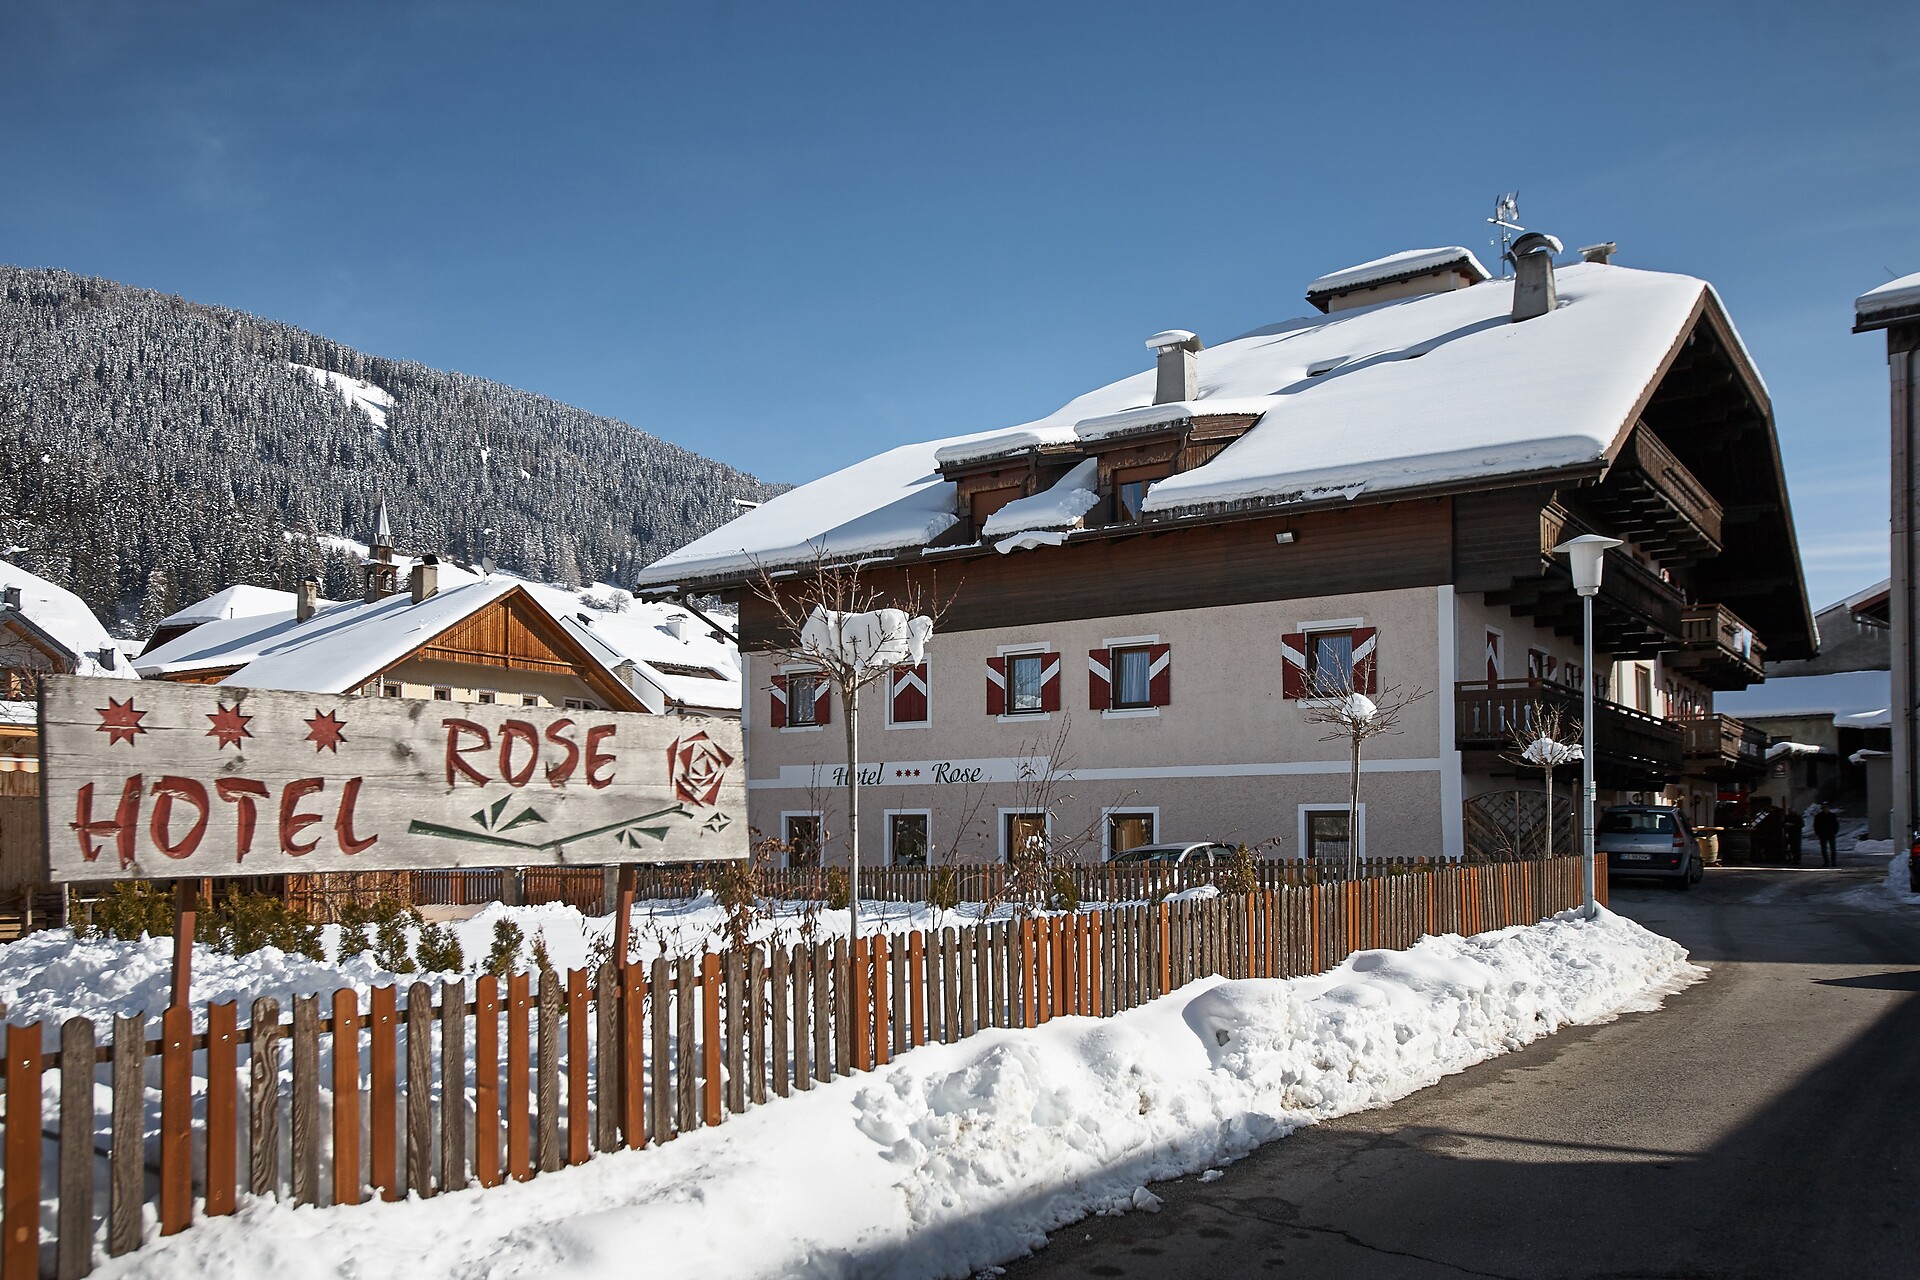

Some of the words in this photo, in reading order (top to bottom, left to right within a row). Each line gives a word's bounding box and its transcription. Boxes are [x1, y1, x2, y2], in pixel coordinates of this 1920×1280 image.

[442, 717, 618, 789] ROSE
[931, 761, 984, 784] Rose
[70, 772, 379, 870] HOTEL
